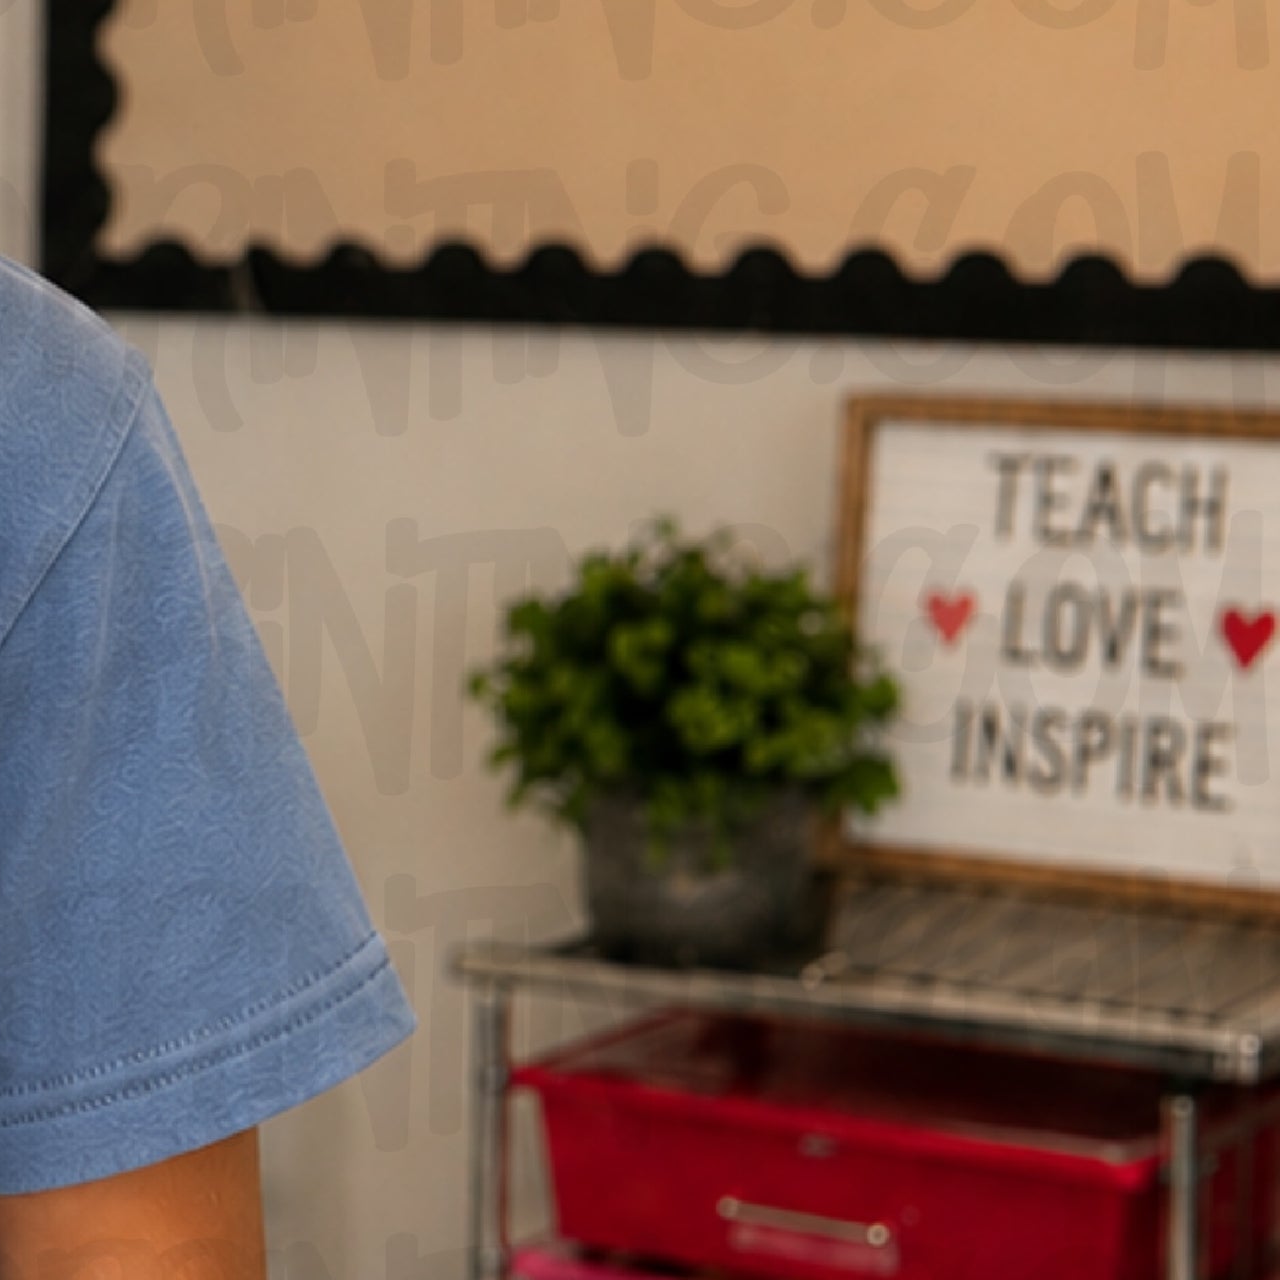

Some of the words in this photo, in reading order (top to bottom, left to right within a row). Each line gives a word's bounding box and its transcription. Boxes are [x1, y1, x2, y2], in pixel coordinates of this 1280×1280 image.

[990, 450, 1230, 556] TEACH
[1001, 583, 1185, 679] LOVE
[949, 700, 1234, 812] INSPIRE
